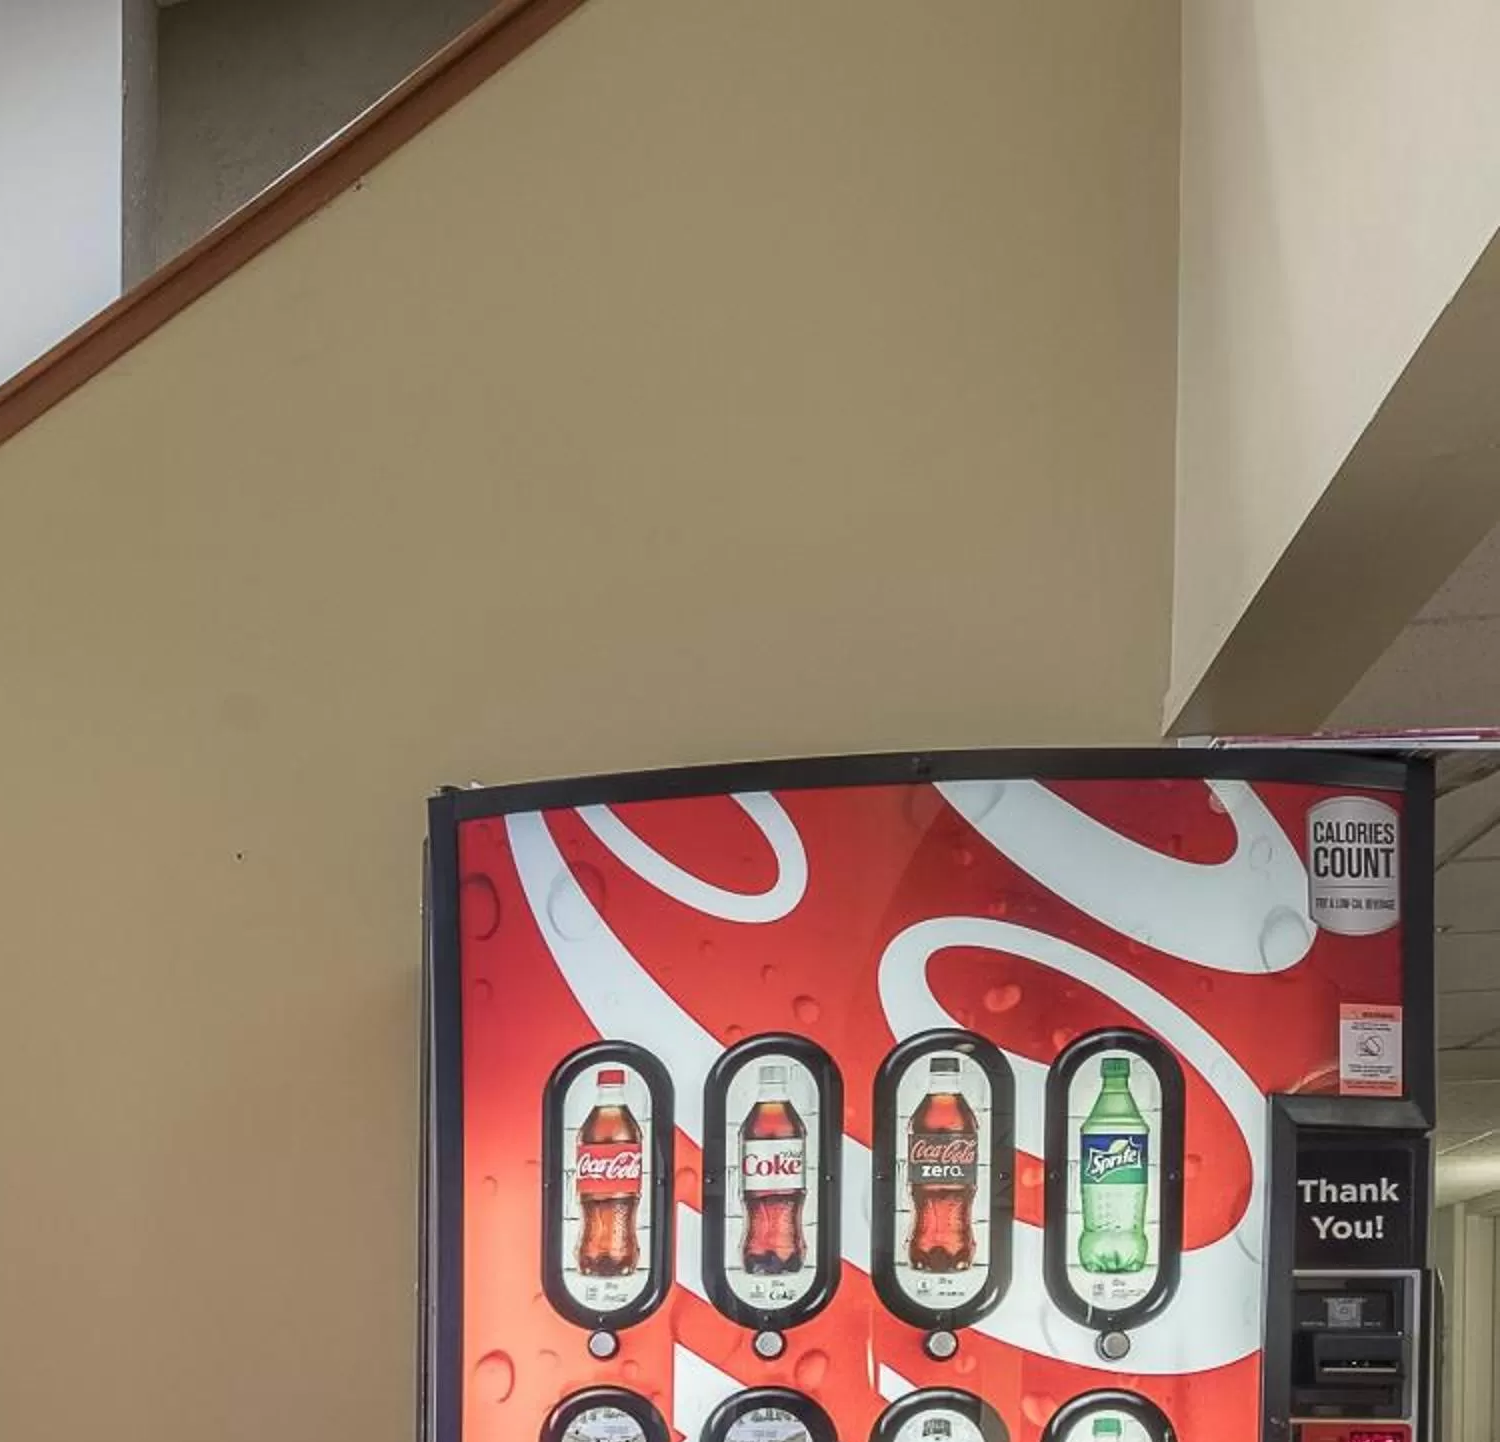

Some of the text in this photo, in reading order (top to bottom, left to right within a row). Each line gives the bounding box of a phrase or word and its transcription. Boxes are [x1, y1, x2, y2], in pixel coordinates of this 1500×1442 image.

[1313, 821, 1395, 844] CALORIES
[1313, 846, 1395, 878] COUNT
[742, 1153, 802, 1176] Coke
[1091, 1147, 1137, 1174] Sprite
[1297, 1177, 1401, 1203] Thank
[1311, 1215, 1385, 1240] You!
